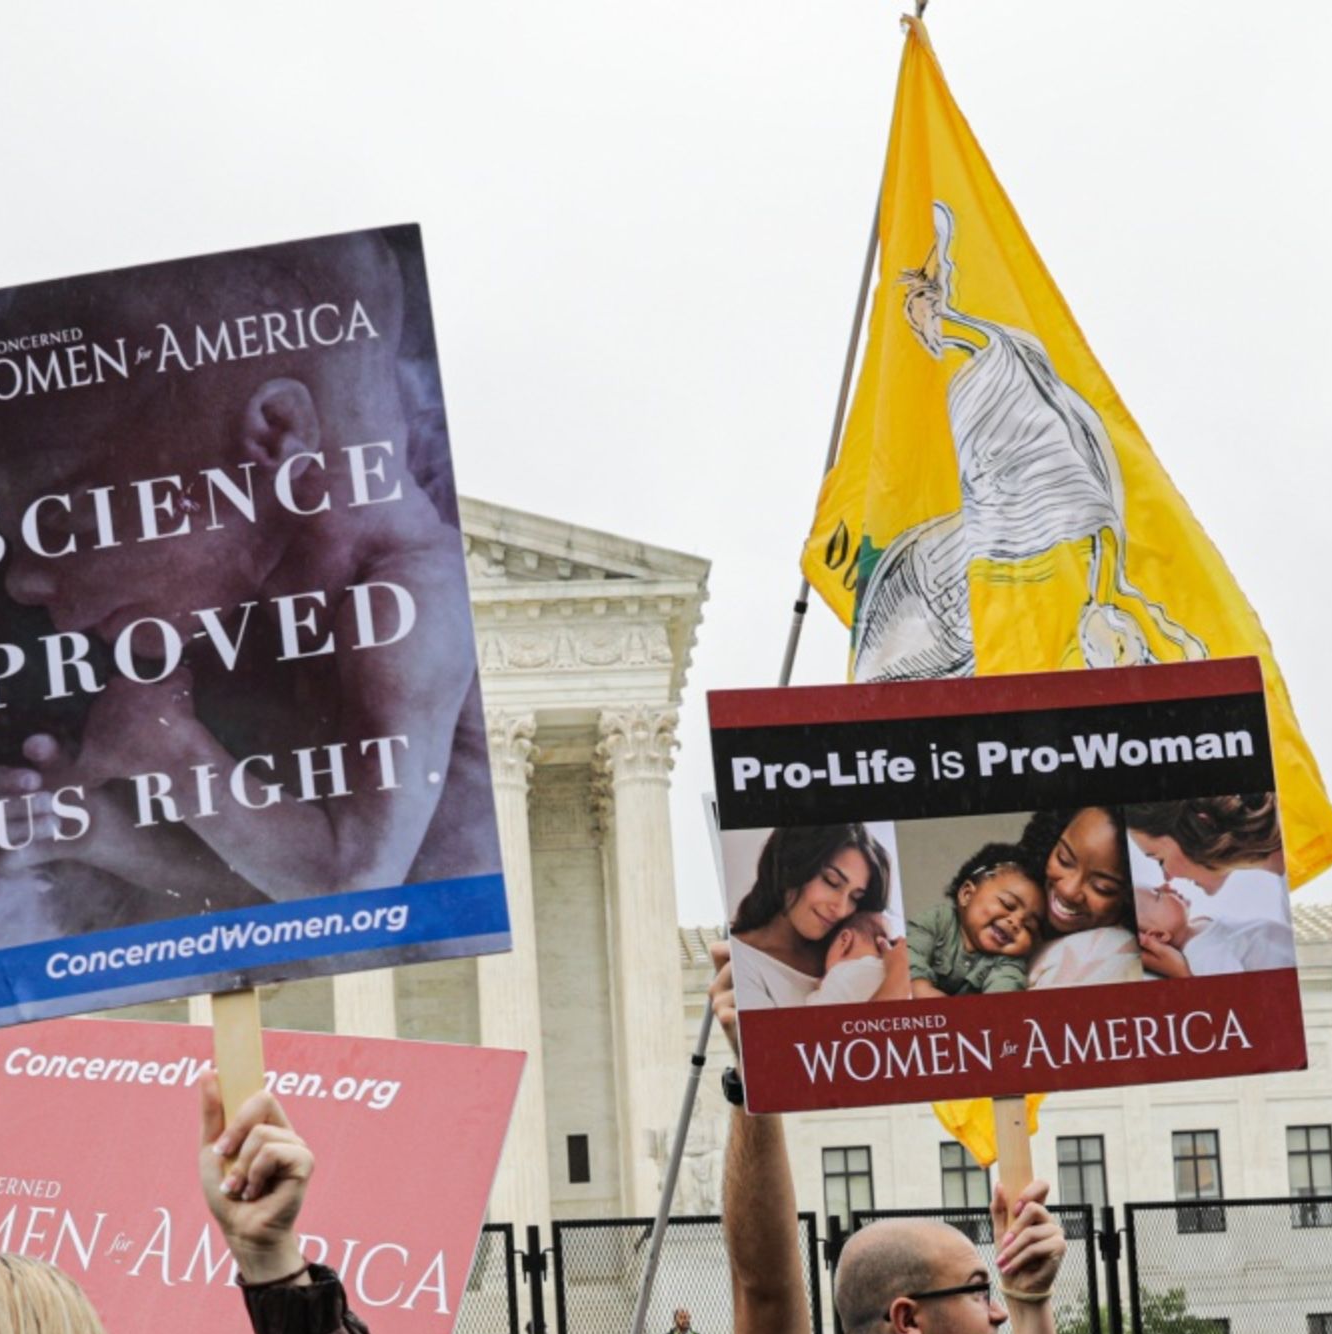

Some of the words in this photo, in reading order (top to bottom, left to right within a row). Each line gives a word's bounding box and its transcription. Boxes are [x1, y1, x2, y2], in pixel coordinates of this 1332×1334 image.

[134, 344, 155, 365] for
[154, 298, 380, 374] AMERICA
[131, 734, 442, 829] RIGHT.
[731, 749, 916, 791] Pro-Life
[929, 743, 966, 781] is
[977, 728, 1255, 777] Pro-Woman
[46, 900, 410, 982] ConcernedWomen.org
[794, 1027, 993, 1085] WOMEN
[1000, 1038, 1019, 1059] for
[1022, 1007, 1253, 1069] AMERICA
[841, 1013, 947, 1035] CONCERNED
[105, 1232, 134, 1256] for
[127, 1207, 451, 1314] AMRICA
